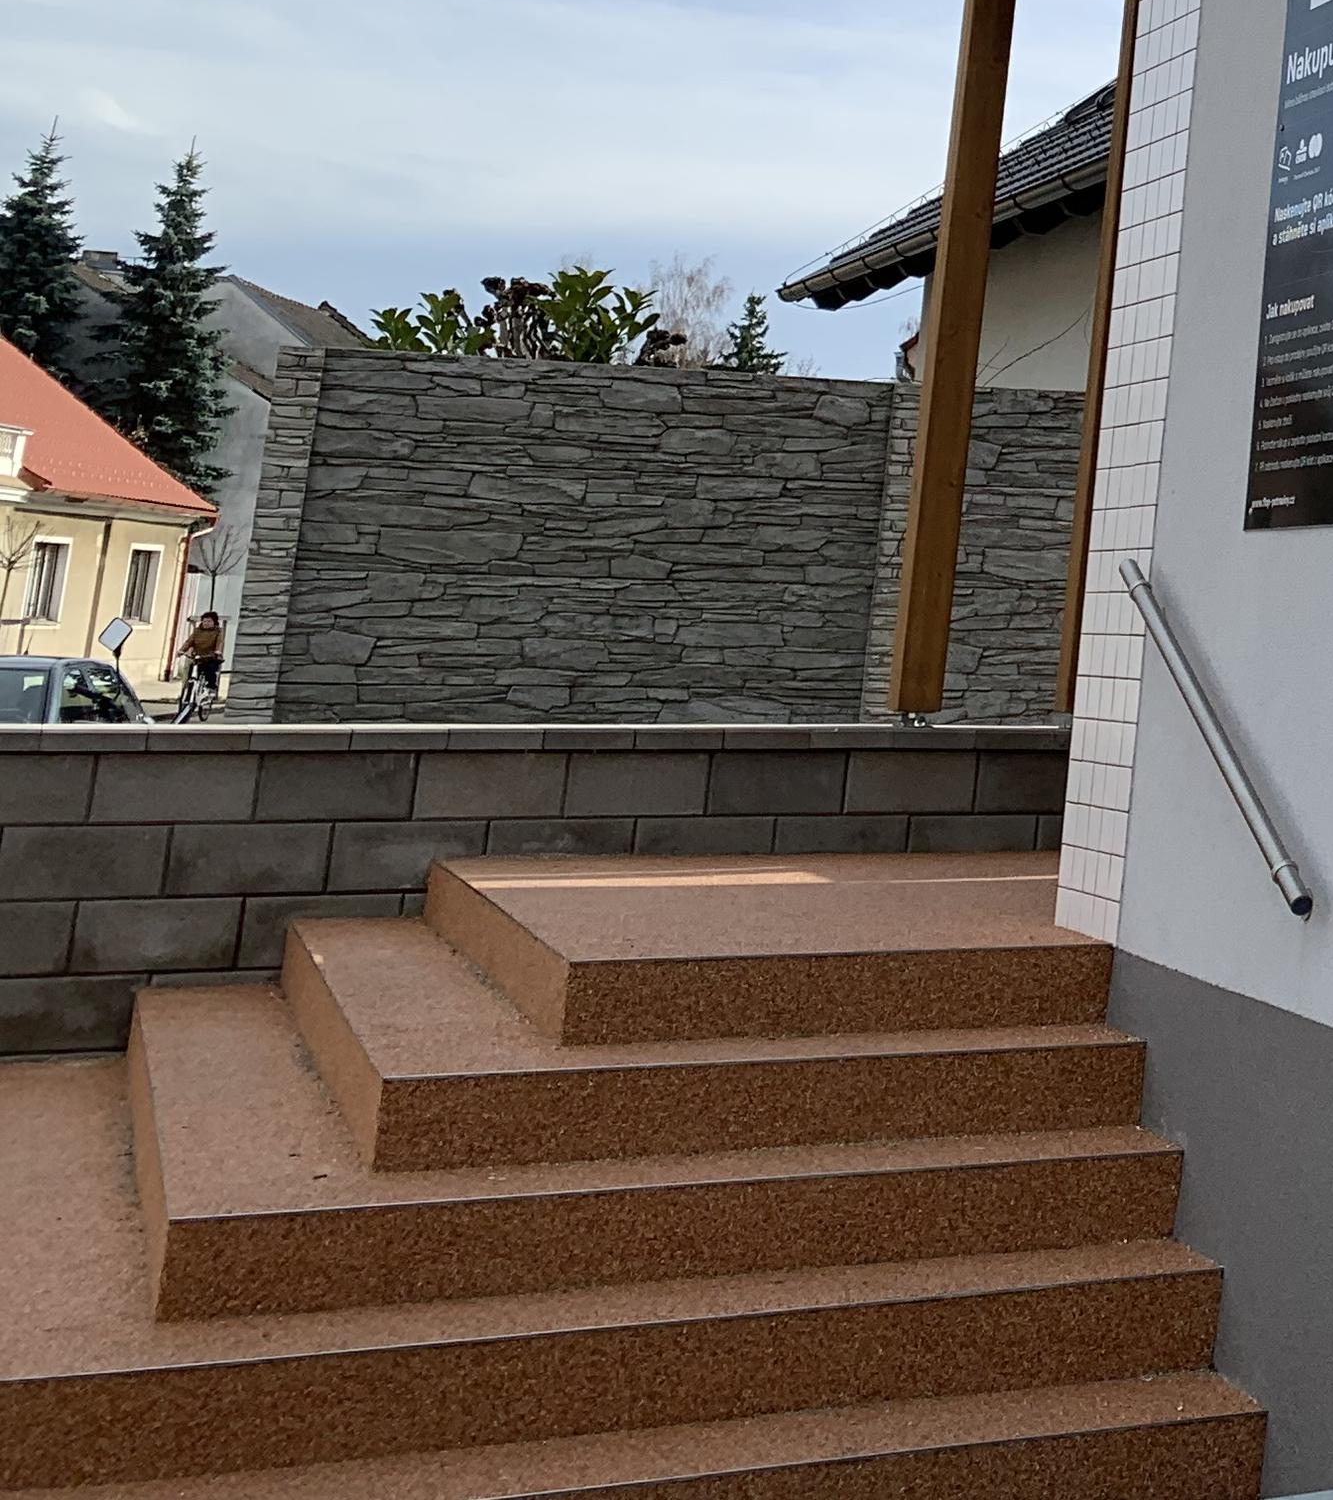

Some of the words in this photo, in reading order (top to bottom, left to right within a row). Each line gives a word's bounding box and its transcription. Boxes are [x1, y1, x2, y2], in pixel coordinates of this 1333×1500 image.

[1274, 198, 1312, 223] Naskenujte
[1312, 192, 1323, 213] QR
[1272, 233, 1278, 246] a
[1278, 220, 1309, 244] stáhněte
[1308, 217, 1317, 234] si
[1266, 302, 1278, 320] Jak
[1279, 294, 1315, 317] nakupovat
